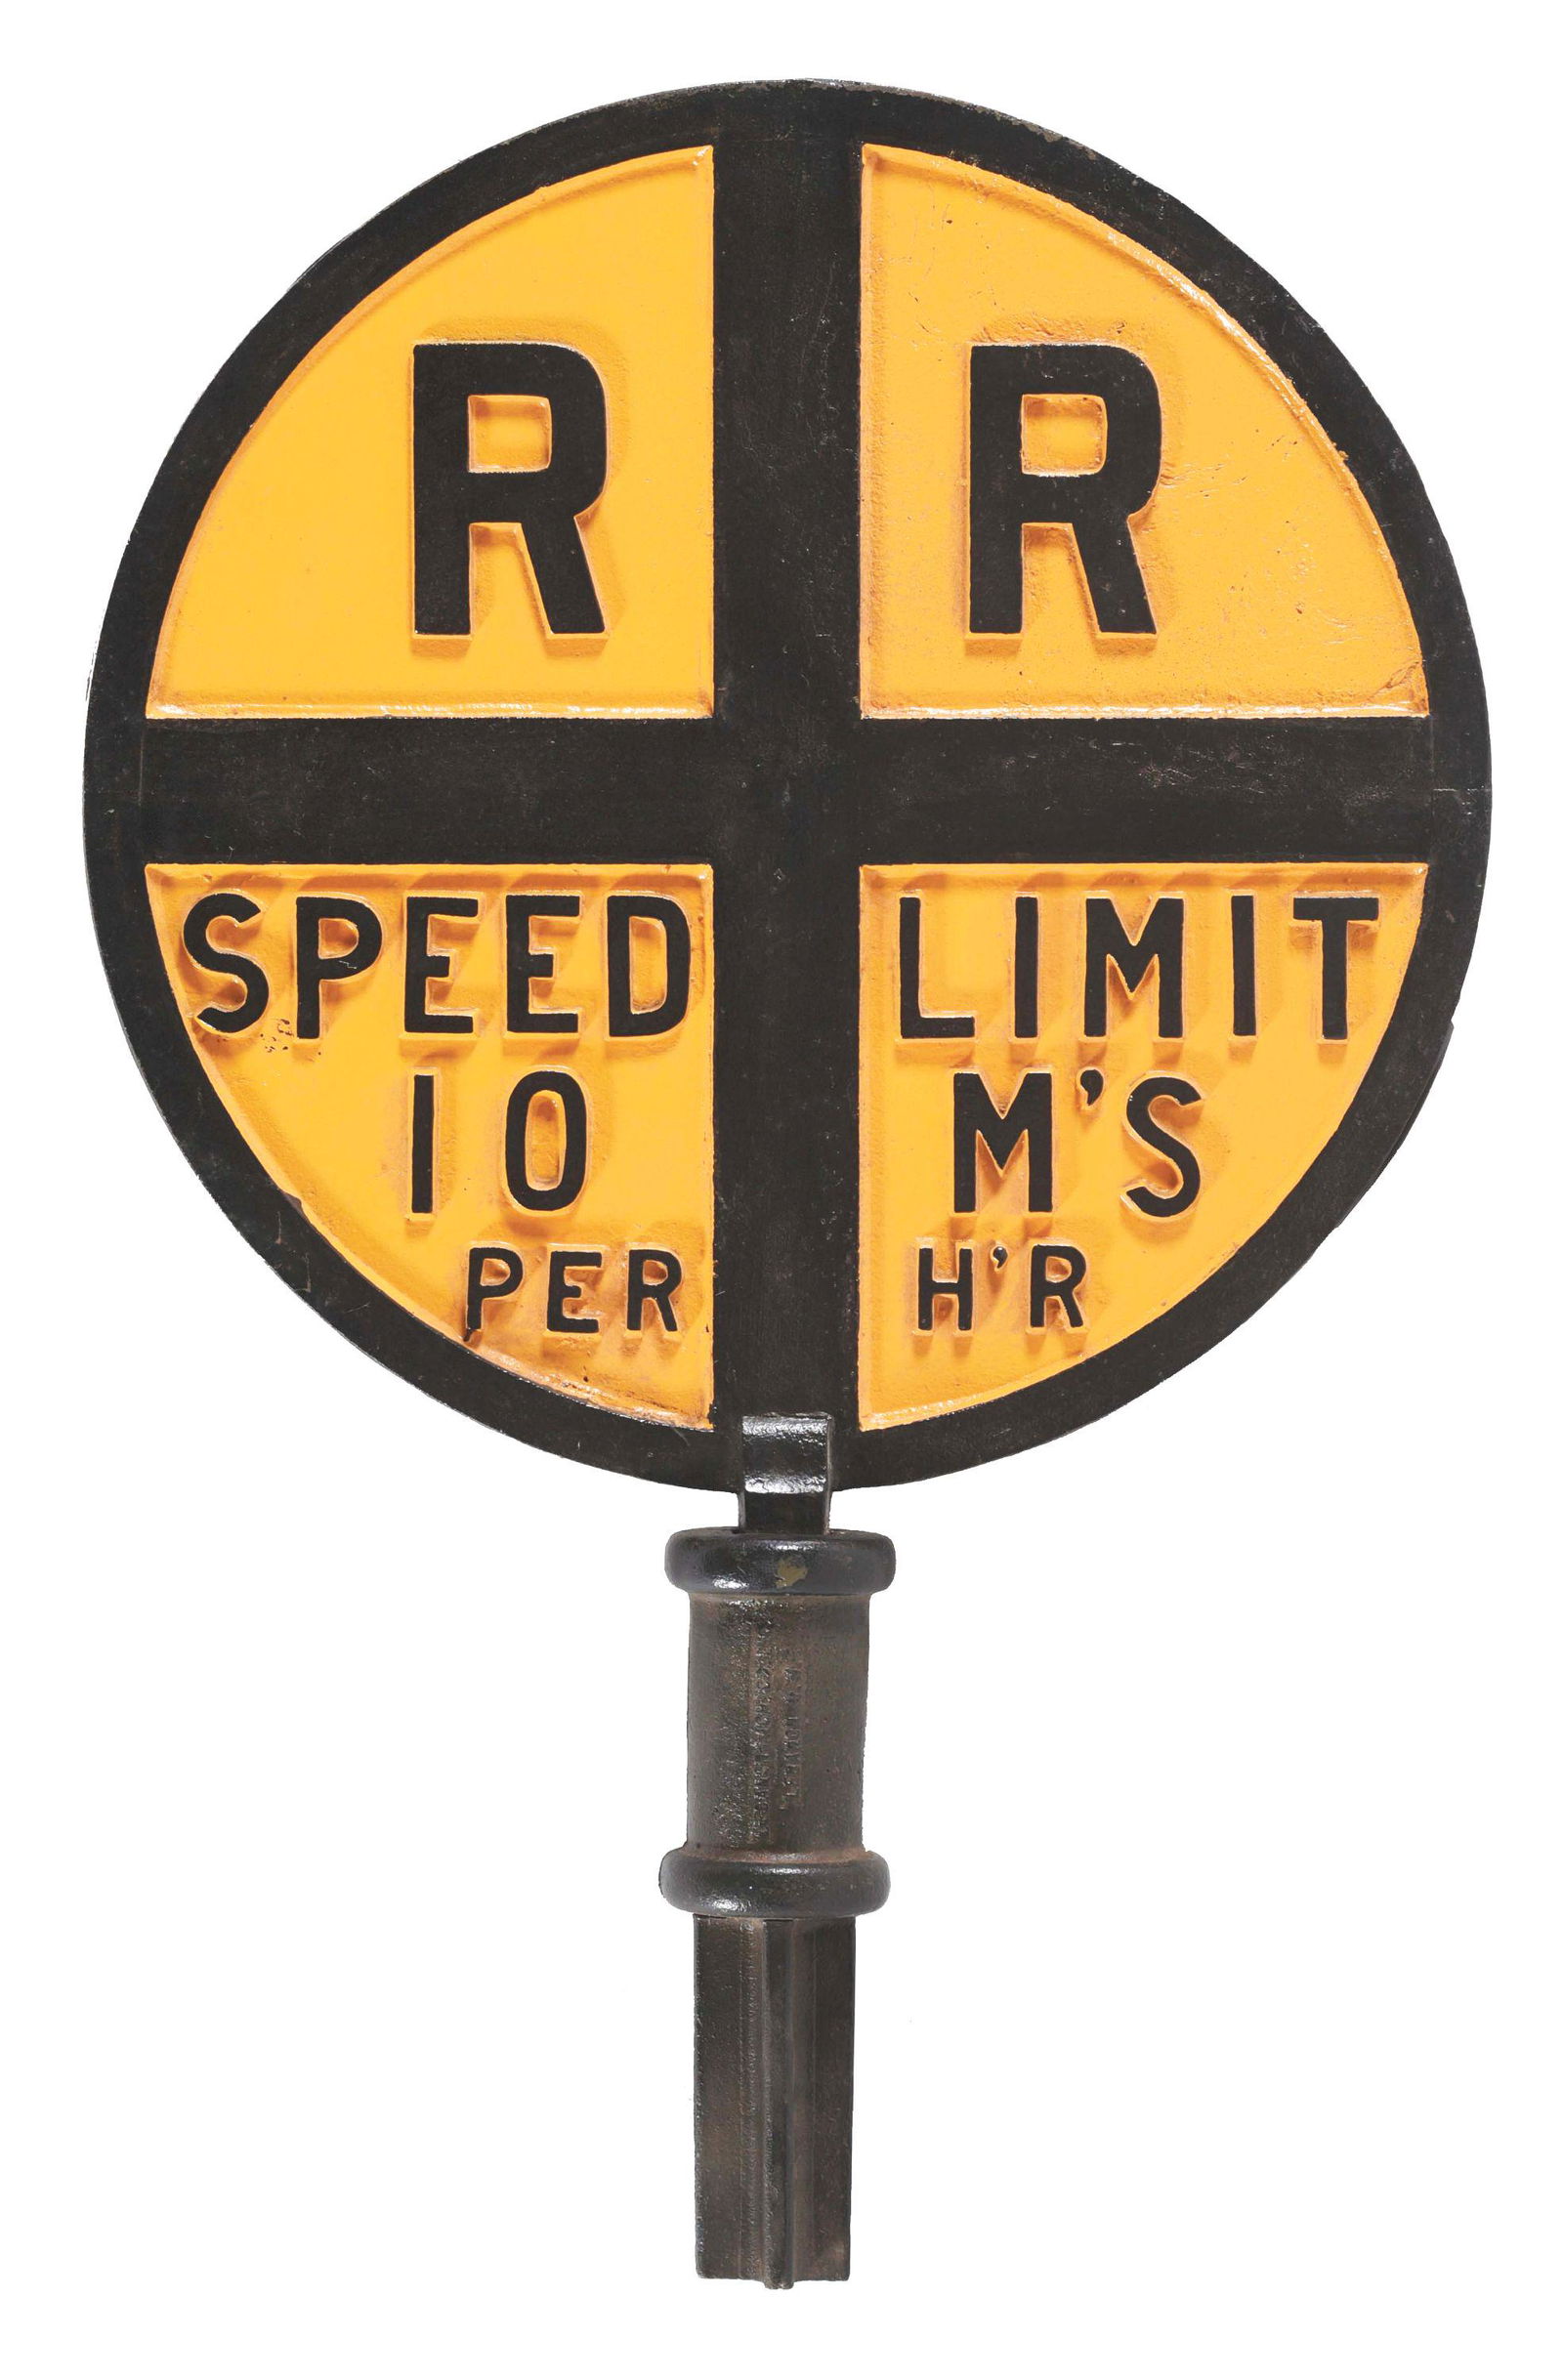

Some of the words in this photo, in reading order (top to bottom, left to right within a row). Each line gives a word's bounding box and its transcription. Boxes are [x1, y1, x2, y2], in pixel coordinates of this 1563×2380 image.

[412, 343, 608, 636] R
[969, 343, 1162, 635] R
[183, 893, 692, 1039] SPEED
[899, 895, 1379, 1040] LIMIT
[411, 1070, 587, 1215] 10
[953, 1069, 1202, 1218] M'S
[465, 1247, 682, 1334] PER
[917, 1244, 1086, 1331] H'R
